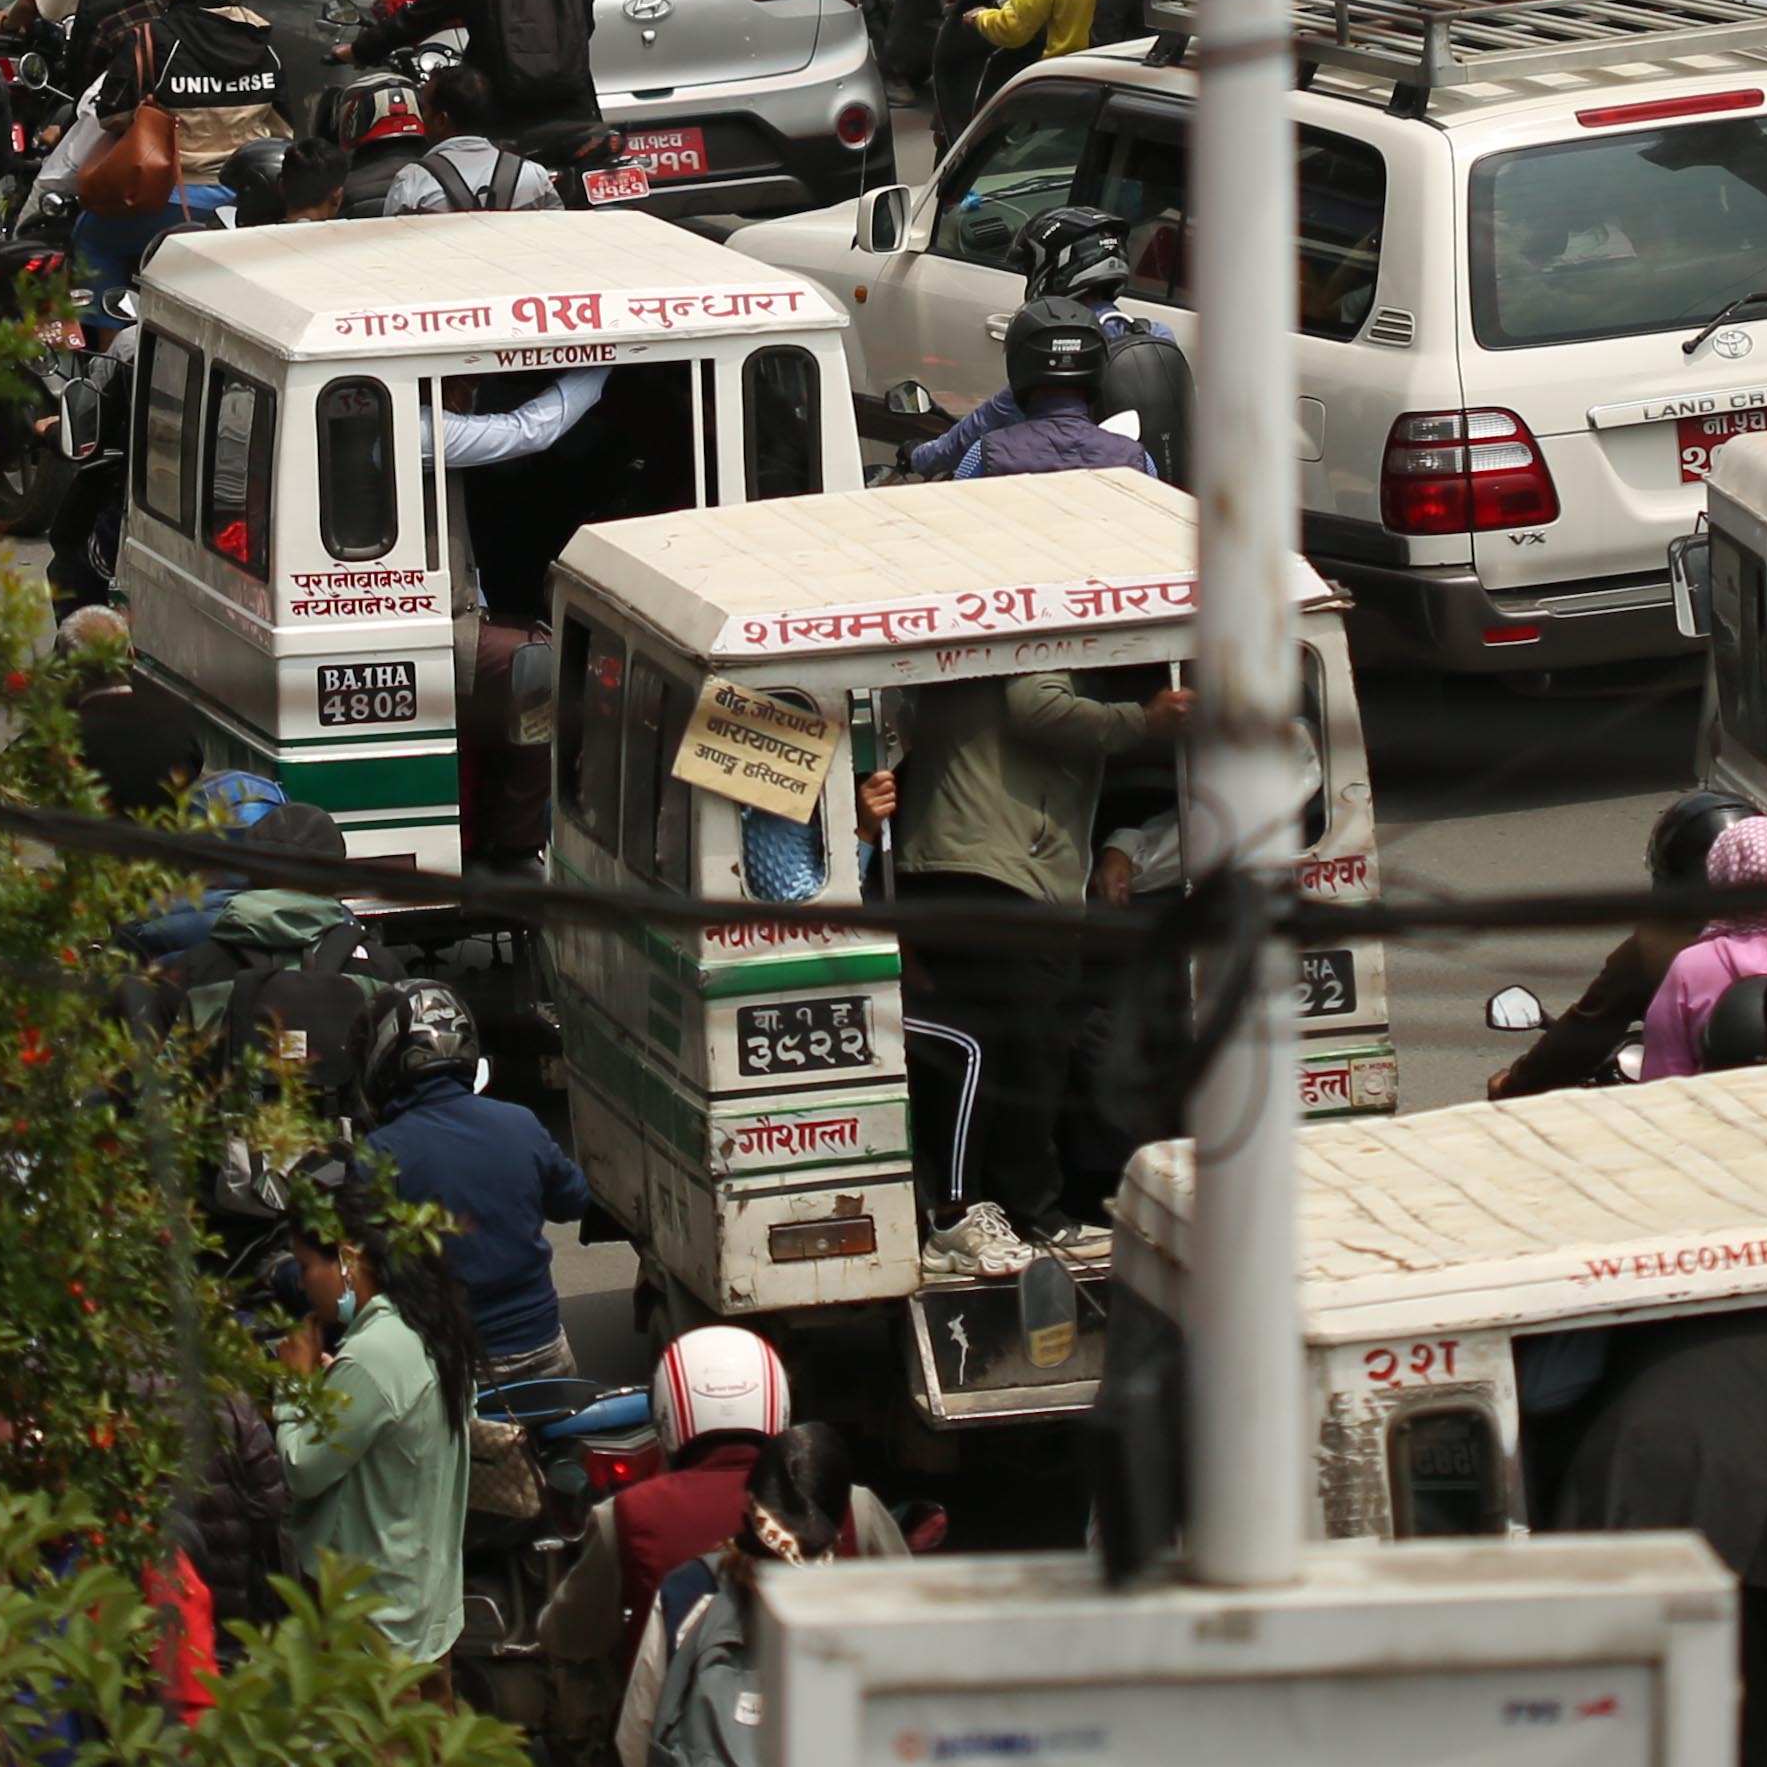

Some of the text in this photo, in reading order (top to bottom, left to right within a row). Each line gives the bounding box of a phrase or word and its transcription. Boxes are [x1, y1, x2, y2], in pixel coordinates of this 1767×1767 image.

[170, 71, 275, 94] UNIVERSE
[628, 291, 805, 330] सुन्धारा
[1643, 398, 1715, 421] LAND
[1507, 533, 1546, 546] VX
[743, 602, 938, 649] शंखमूल
[322, 689, 415, 722] 4802
[704, 718, 822, 773] नारायणटार
[796, 1006, 813, 1027] १
[830, 1003, 852, 1025] ह
[746, 1028, 865, 1073] ३९२२
[735, 1116, 860, 1155] गौशाला
